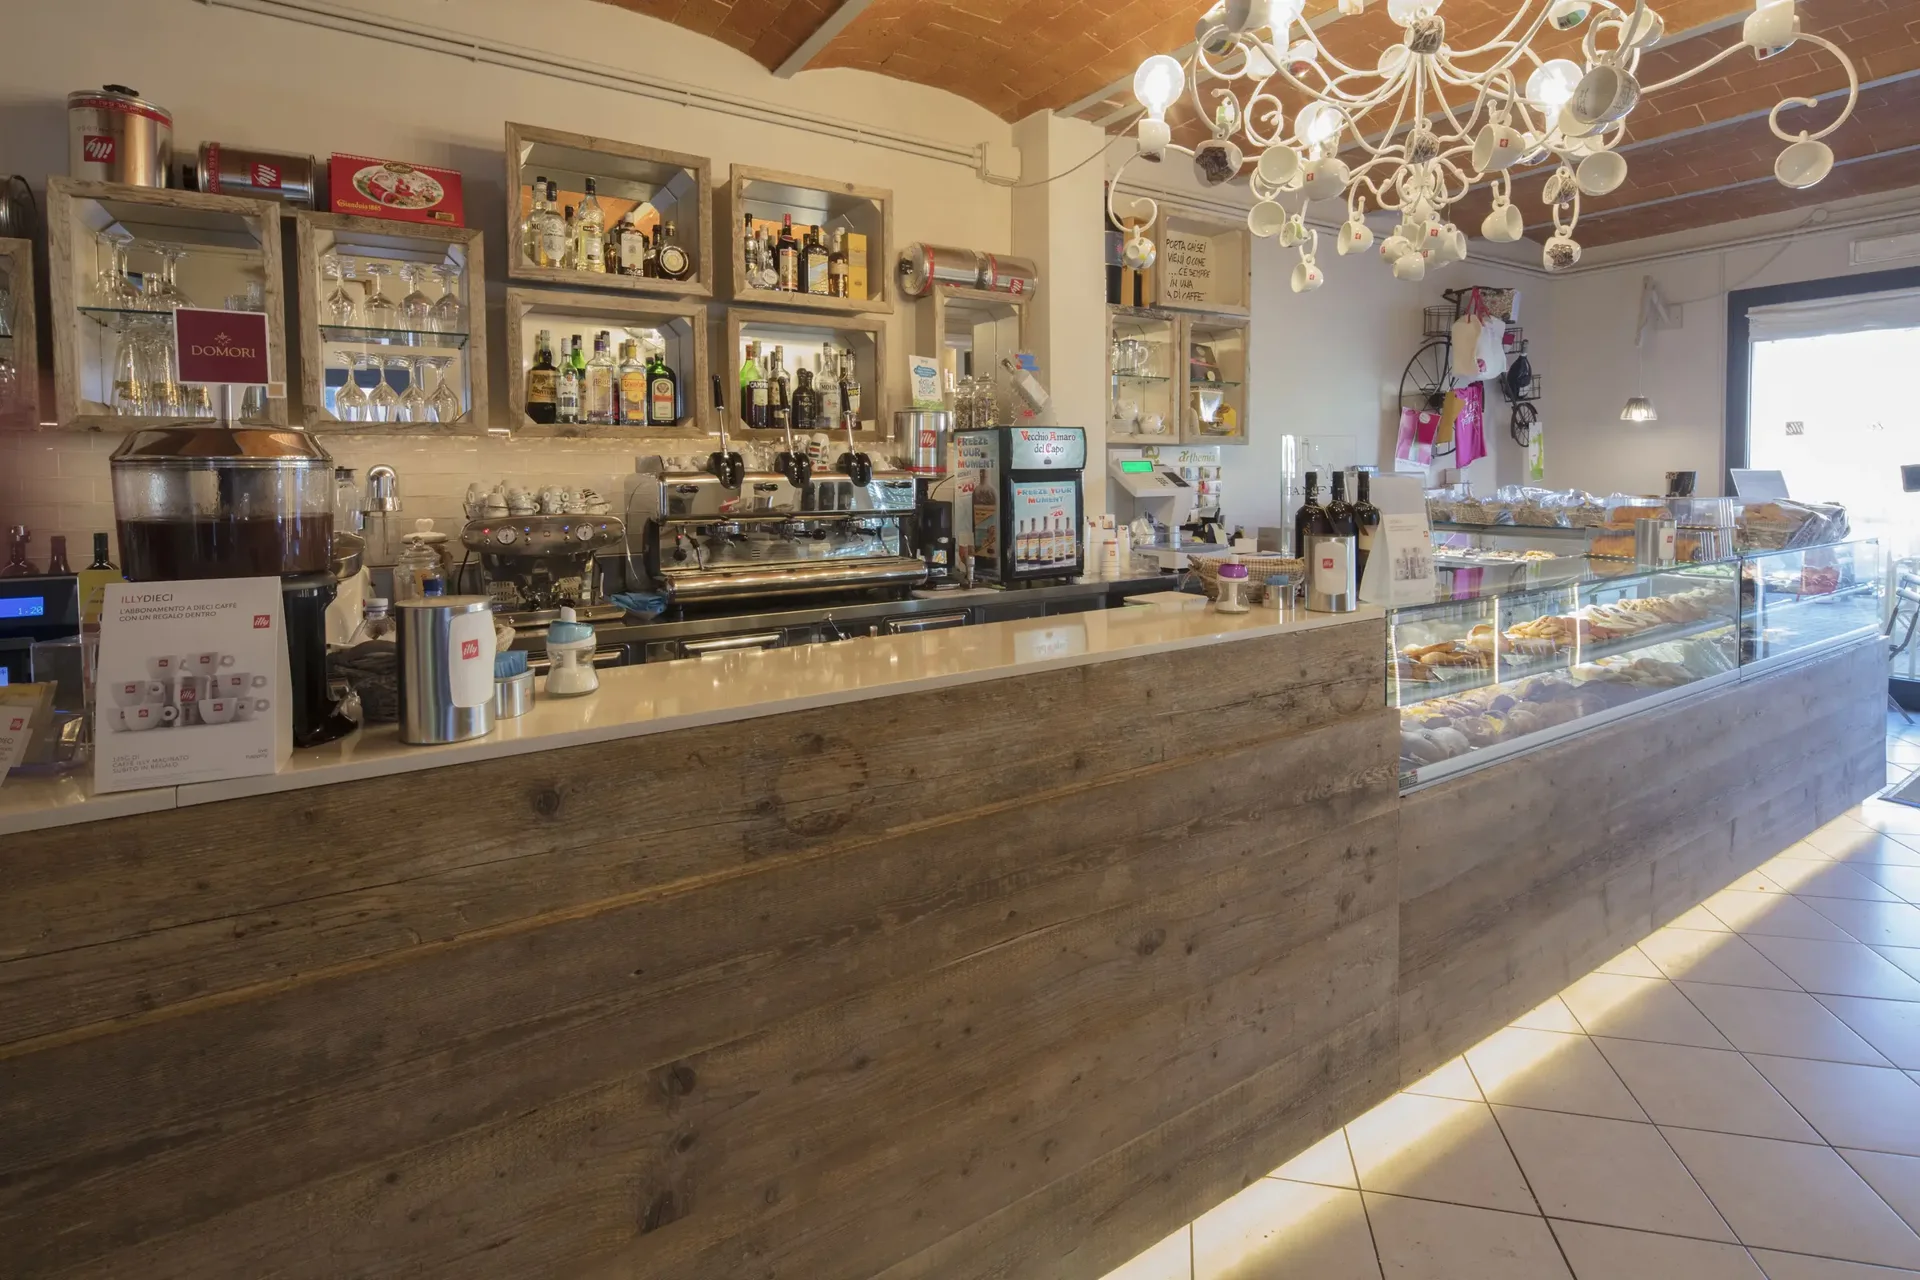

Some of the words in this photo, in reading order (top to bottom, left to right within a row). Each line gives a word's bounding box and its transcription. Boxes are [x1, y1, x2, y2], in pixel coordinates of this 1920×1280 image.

[85, 137, 113, 159] illy
[254, 163, 278, 188] illy
[191, 345, 256, 358] DOMORI
[920, 432, 936, 447] illy
[1021, 430, 1048, 441] Vecchio
[1049, 431, 1076, 441] Amaro
[957, 436, 989, 447] FREEZE
[958, 447, 981, 457] YOUR
[1034, 443, 1045, 453] del
[1045, 442, 1064, 455] Capo
[957, 459, 996, 468] MOMENT
[1017, 488, 1048, 496] FREEZE
[1028, 496, 1064, 504] MOMENT
[121, 593, 174, 604] ILLYDIECI
[120, 605, 185, 615] L'ABBONAMENTO
[193, 603, 214, 611] DIECI
[152, 612, 183, 620] REGALO
[185, 611, 217, 619] DENTRO
[254, 615, 270, 627] illy
[462, 640, 479, 656] illy
[181, 690, 195, 701] illy
